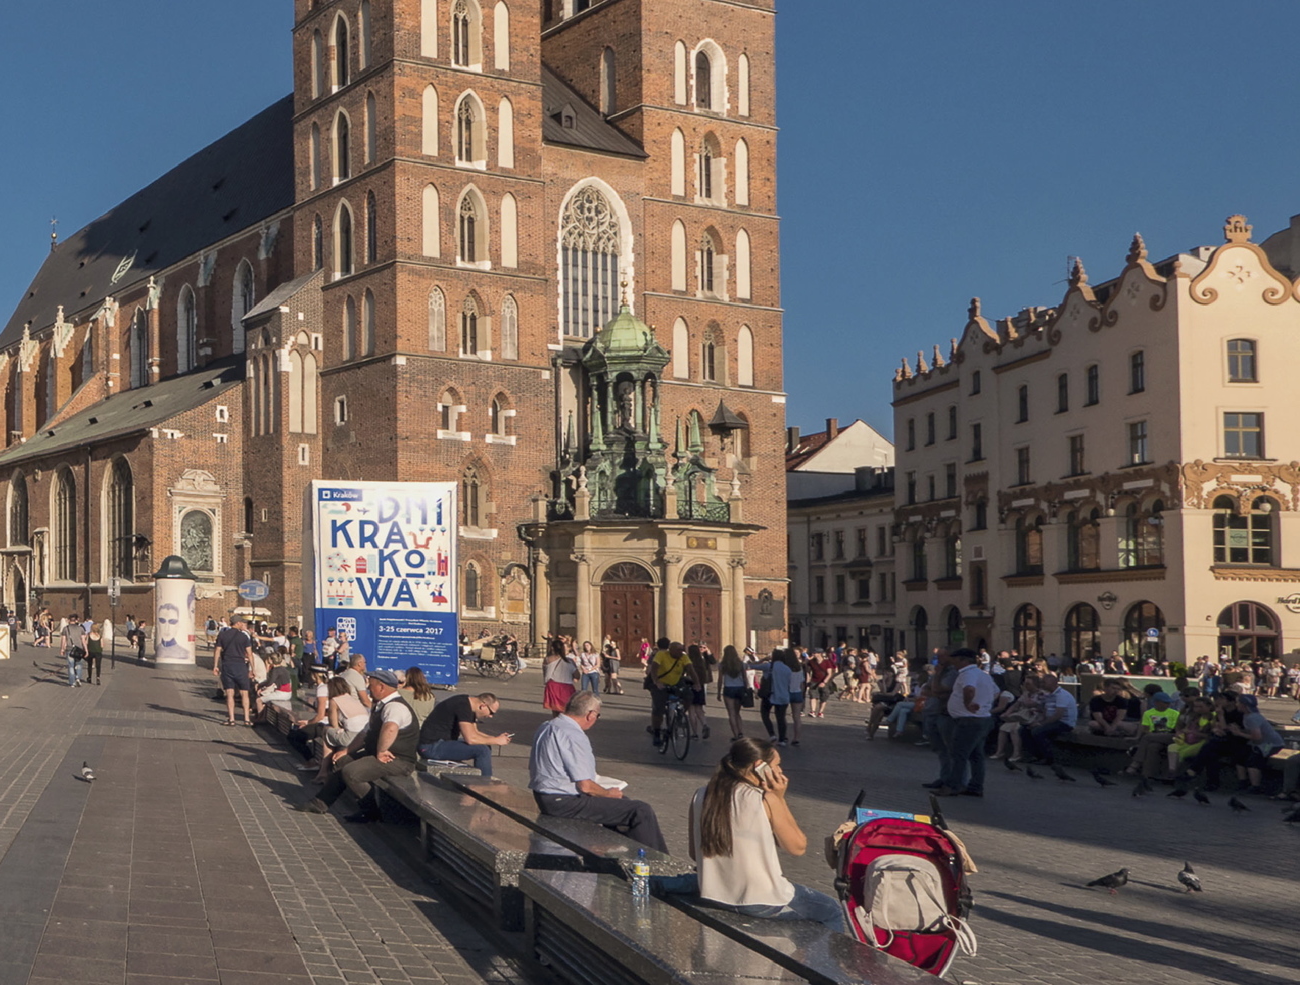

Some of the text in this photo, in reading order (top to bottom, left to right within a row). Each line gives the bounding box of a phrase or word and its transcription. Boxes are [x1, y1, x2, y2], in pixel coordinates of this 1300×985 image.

[331, 519, 408, 549] KRA
[378, 549, 425, 578] KO
[355, 577, 417, 607] WA
[425, 627, 444, 635] 2017
